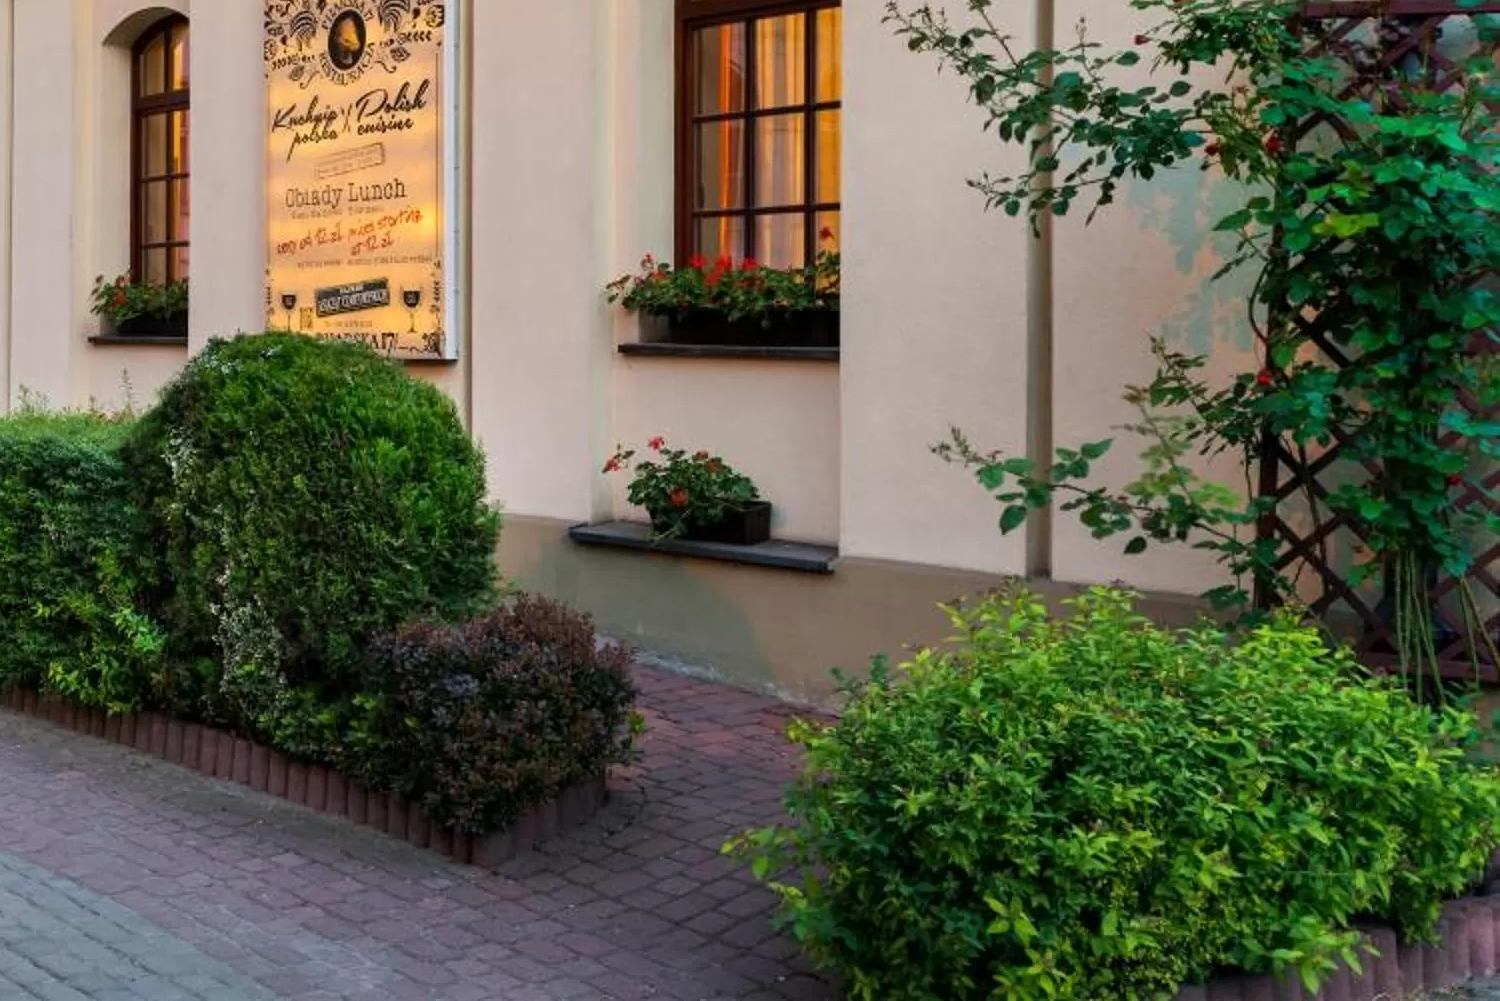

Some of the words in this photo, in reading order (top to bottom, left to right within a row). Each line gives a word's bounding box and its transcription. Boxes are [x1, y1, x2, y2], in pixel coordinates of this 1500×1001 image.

[355, 79, 429, 122] Polish
[286, 120, 339, 163] polska
[357, 114, 414, 135] cuisine
[285, 185, 344, 209] Obiady
[348, 178, 408, 202] Lunch
